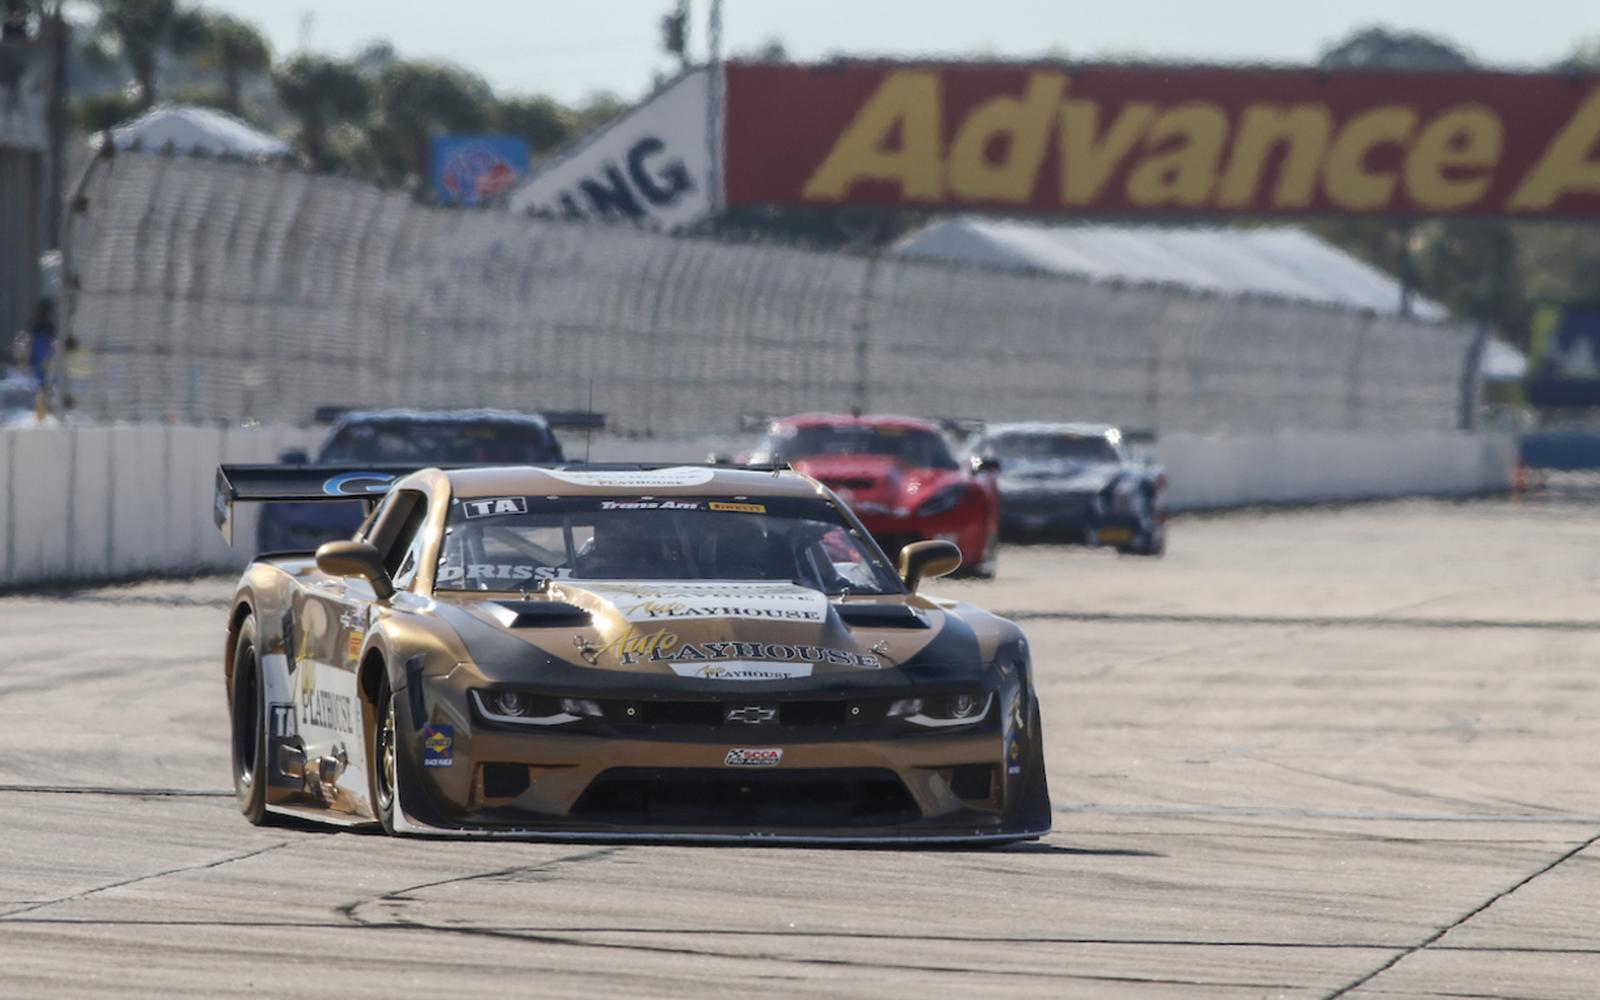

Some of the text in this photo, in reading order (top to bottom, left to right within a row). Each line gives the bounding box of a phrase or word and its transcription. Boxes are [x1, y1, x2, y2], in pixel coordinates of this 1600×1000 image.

[804, 70, 1504, 208] Advance
[471, 499, 519, 515] TA
[601, 501, 698, 510] Trans Am
[437, 564, 573, 582] DRISSI
[648, 606, 820, 620] PLAYHOUSE
[591, 625, 679, 661] Auto
[620, 641, 882, 669] PLAYHOUSE
